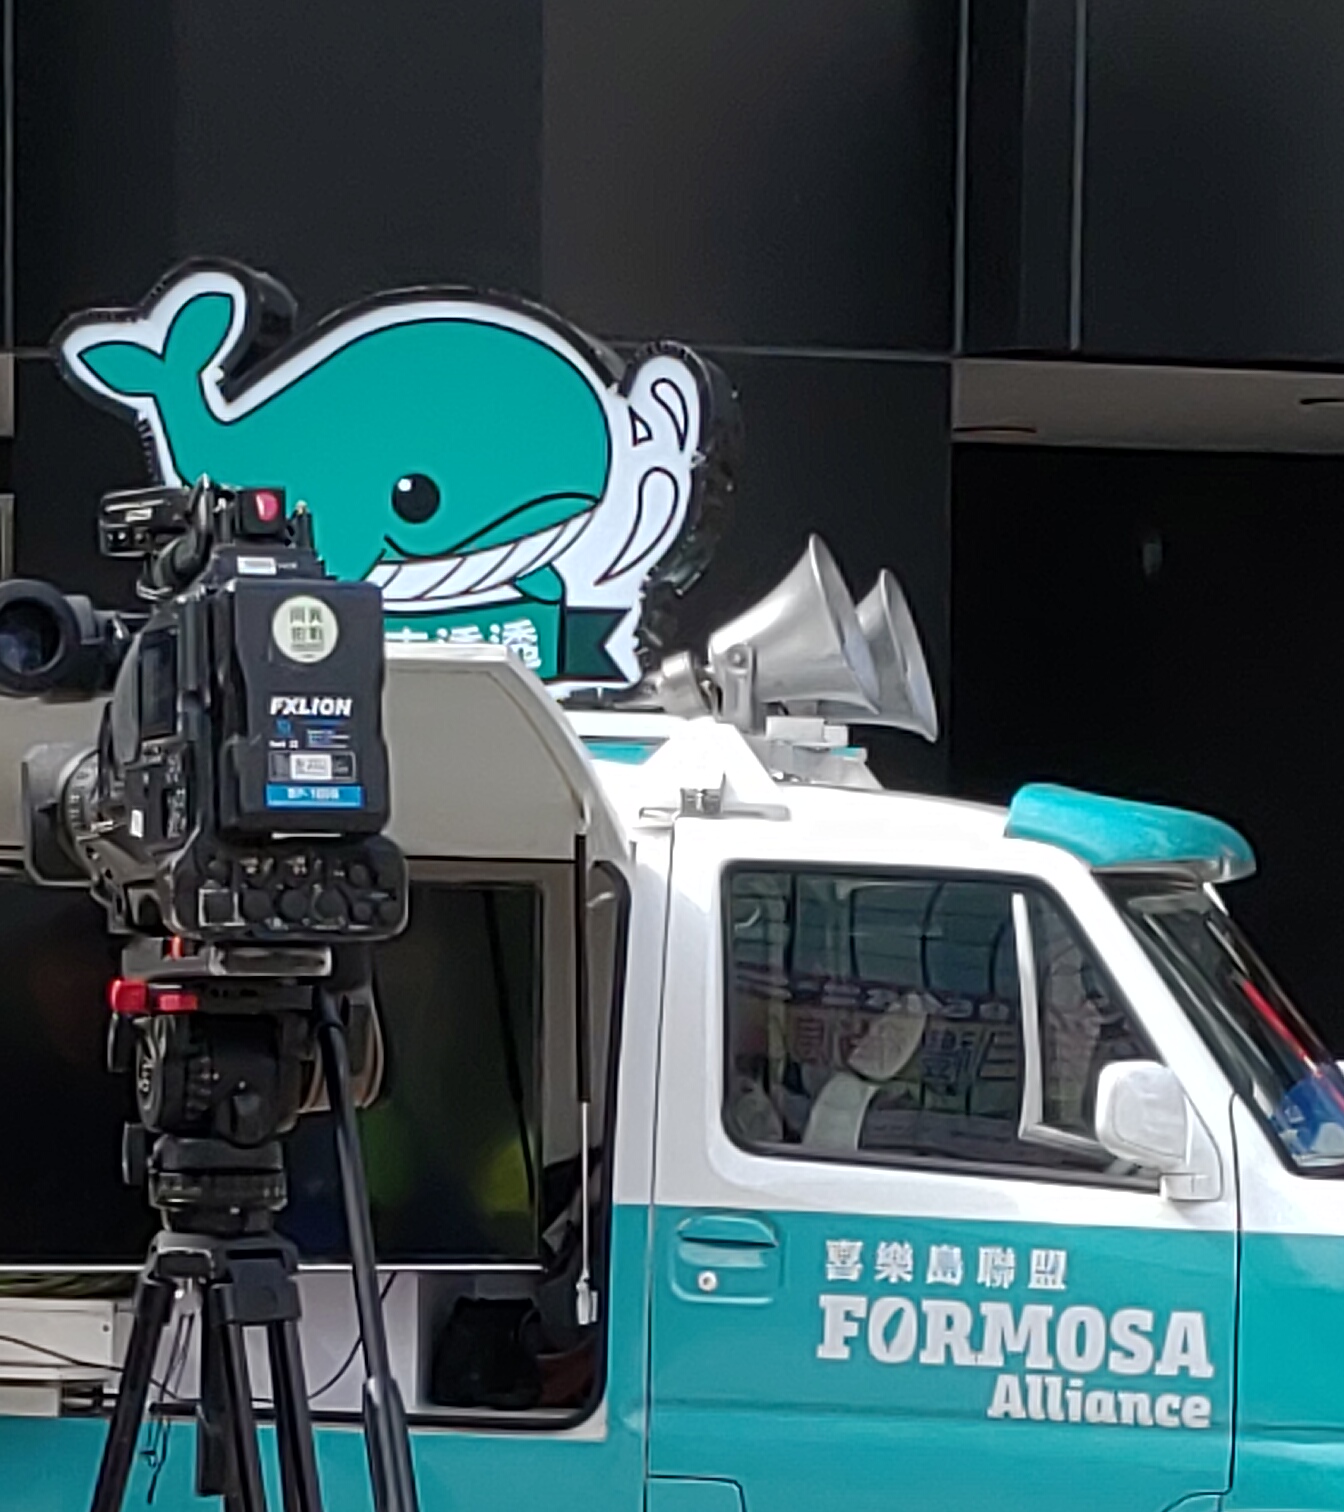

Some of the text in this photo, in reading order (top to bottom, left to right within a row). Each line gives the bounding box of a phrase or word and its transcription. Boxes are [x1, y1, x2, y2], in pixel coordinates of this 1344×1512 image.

[269, 696, 354, 716] FXLION
[824, 1239, 1068, 1290] 喜樂島聯盟
[816, 1294, 1214, 1379] FORMOSA
[987, 1374, 1211, 1428] Alliance
